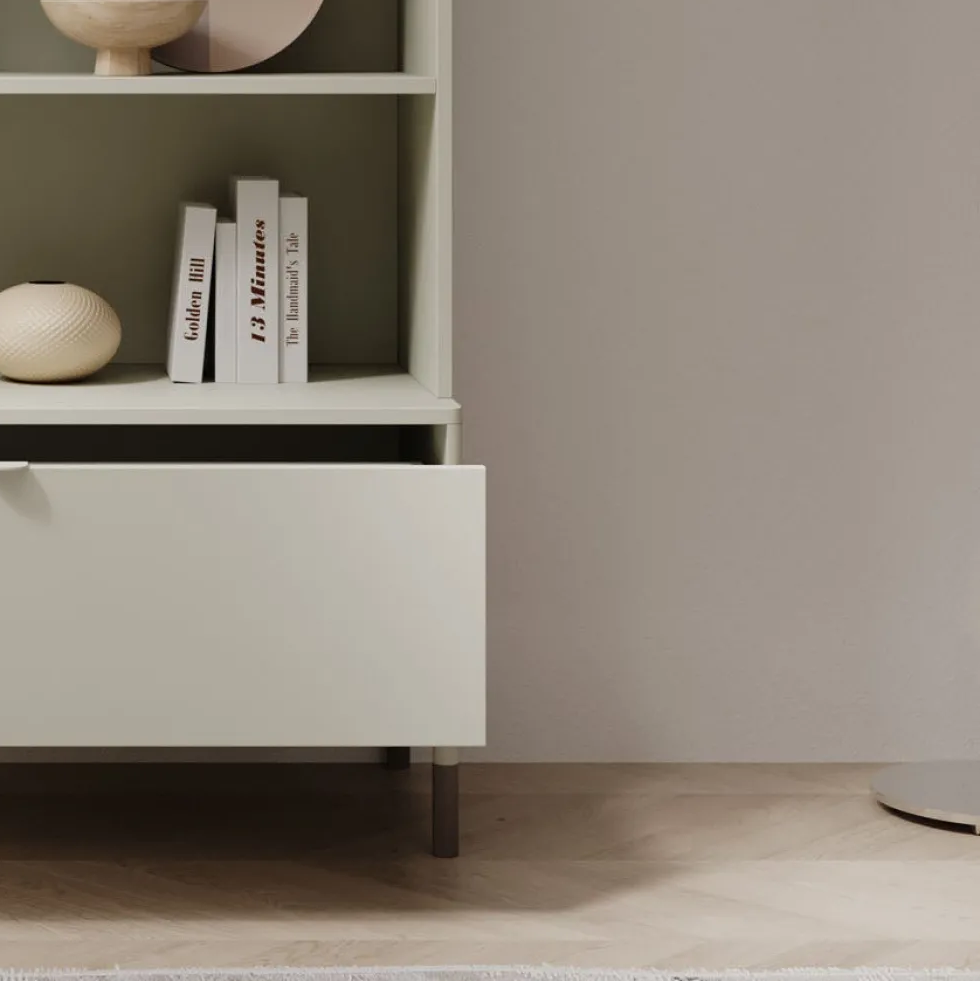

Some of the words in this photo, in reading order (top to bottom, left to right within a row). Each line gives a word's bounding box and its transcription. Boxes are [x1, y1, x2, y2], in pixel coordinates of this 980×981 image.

[286, 232, 300, 254] Tale
[188, 257, 206, 283] Hill
[250, 219, 266, 310] Minutes
[286, 260, 299, 321] Handmaid's
[183, 291, 203, 341] Golden
[250, 316, 266, 343] 13
[286, 327, 299, 347] The
